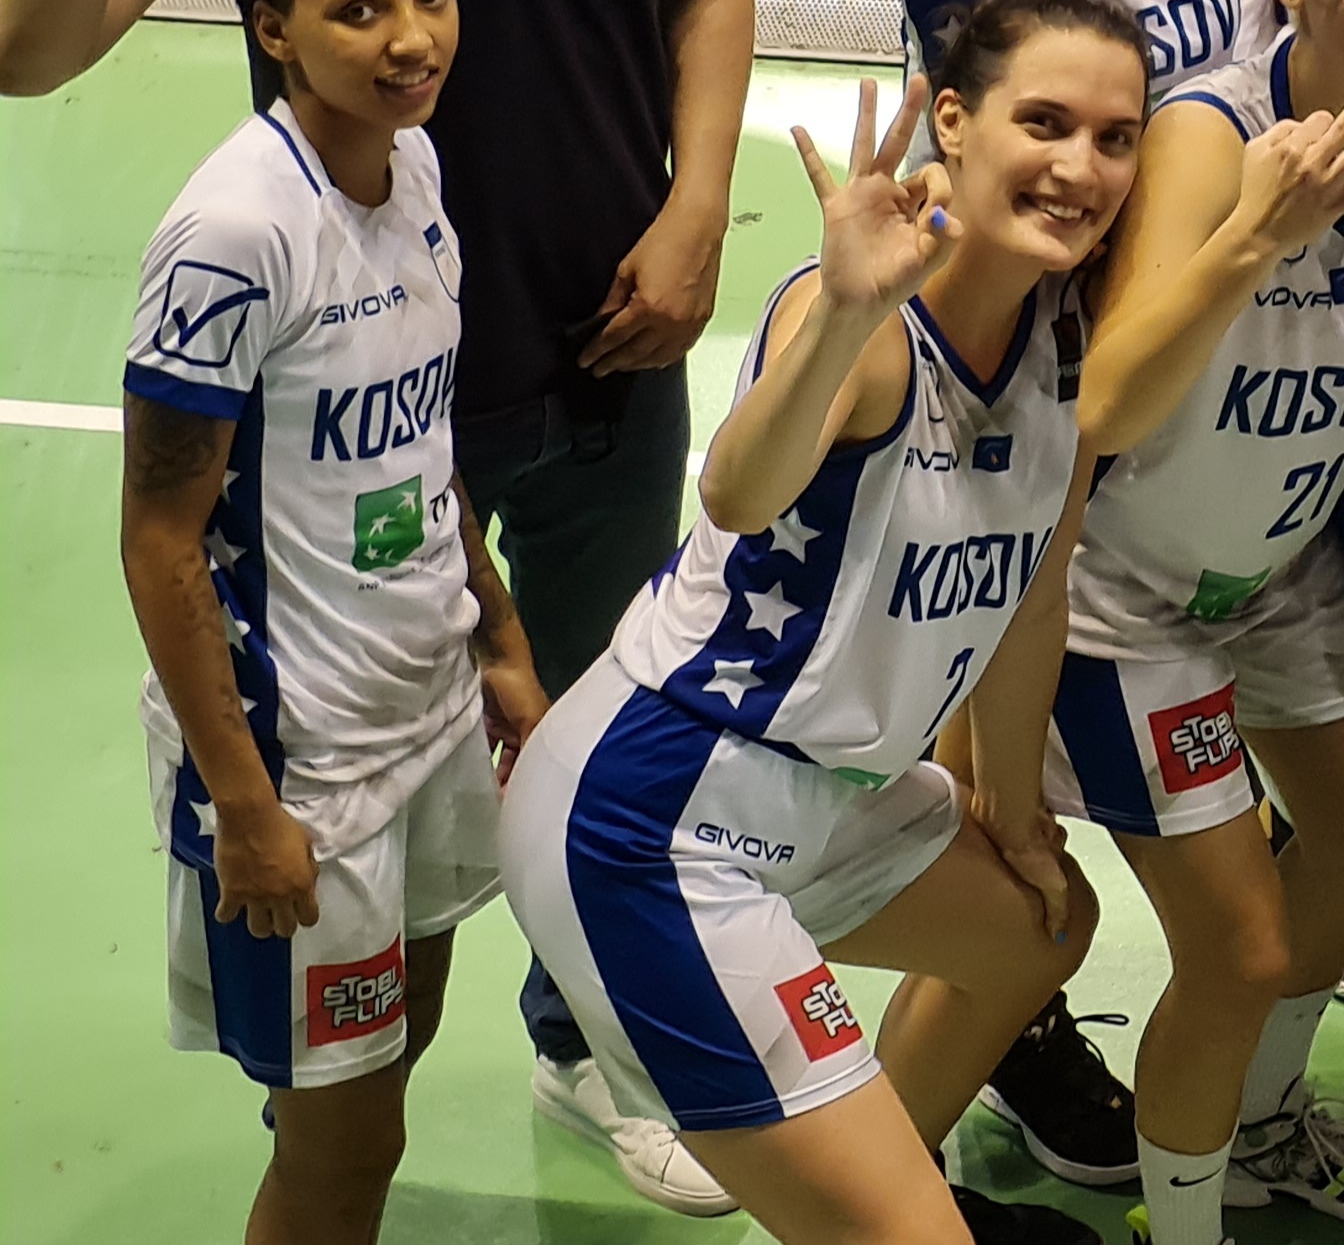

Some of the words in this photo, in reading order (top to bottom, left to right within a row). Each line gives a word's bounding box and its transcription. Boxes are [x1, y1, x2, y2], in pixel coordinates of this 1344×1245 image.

[320, 285, 408, 325] GIVOVA
[1255, 287, 1332, 310] VOVA
[888, 527, 1053, 623] KOSOV
[695, 822, 795, 864] GIVOVA
[323, 966, 396, 1007] STOBI
